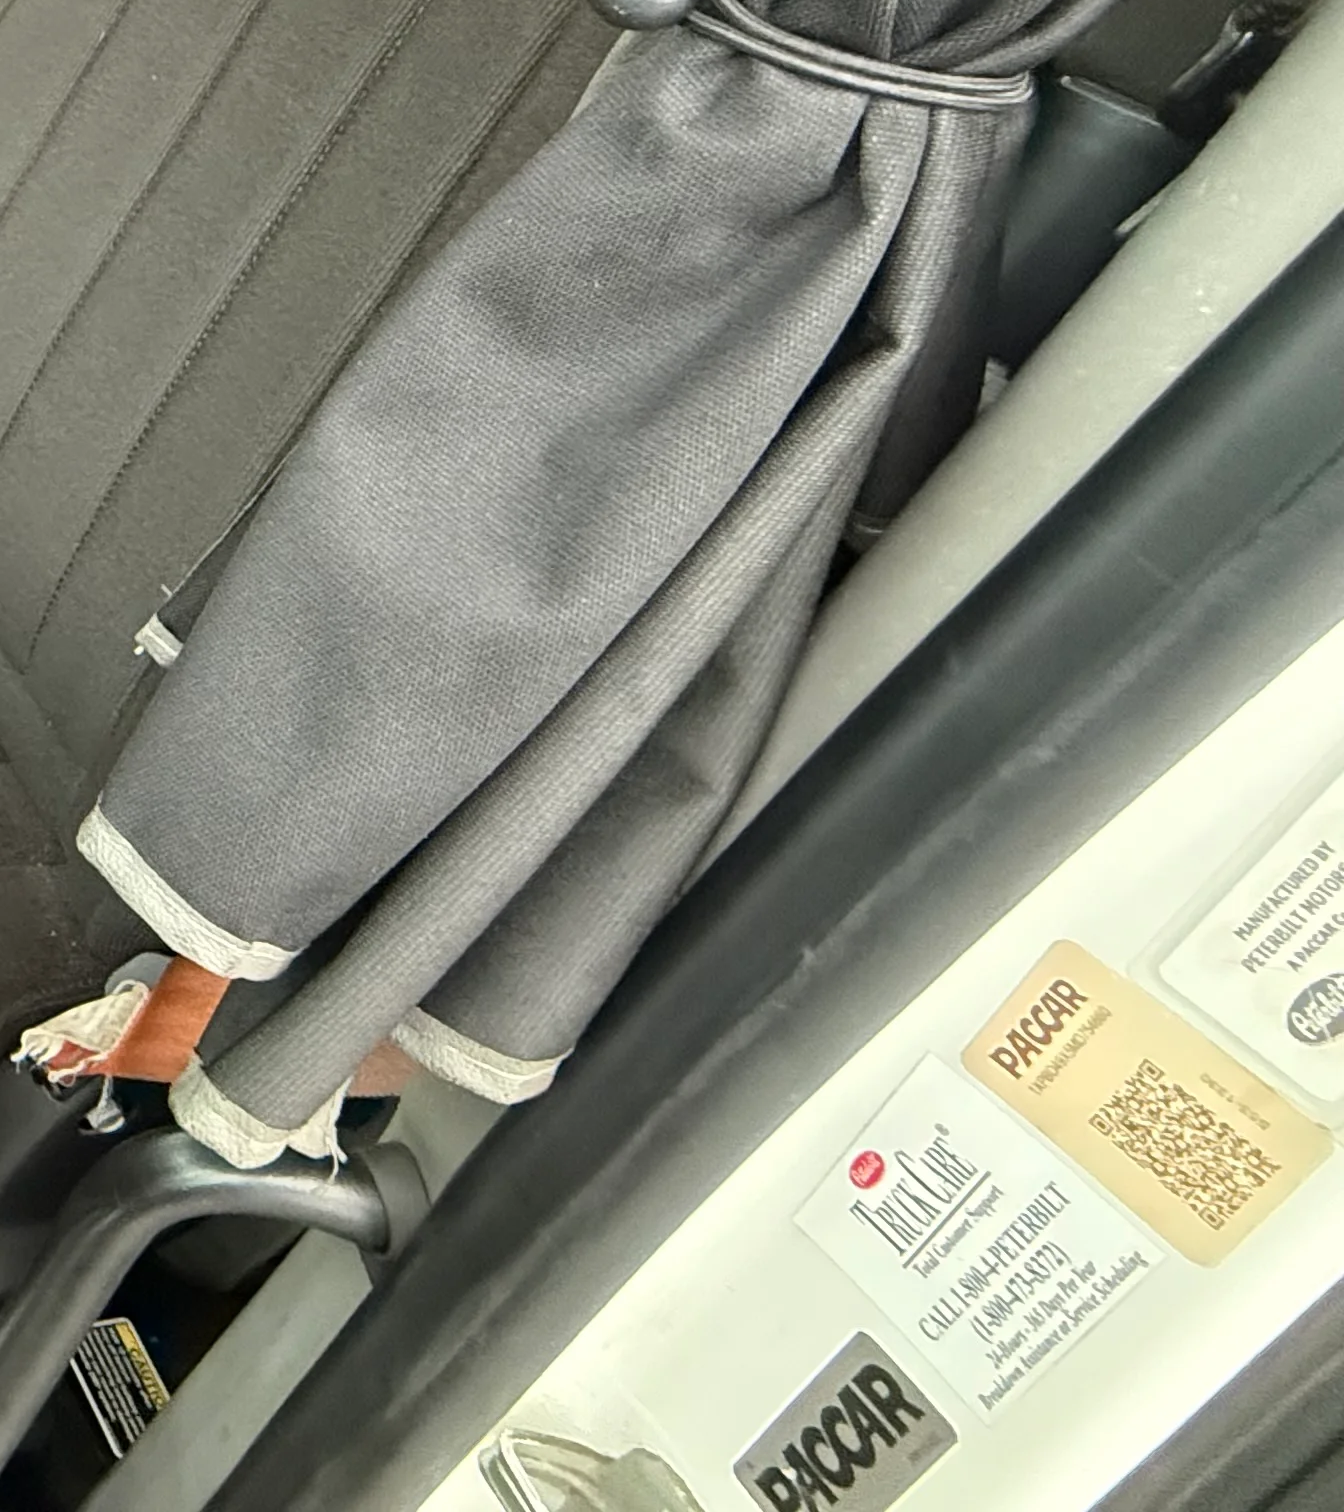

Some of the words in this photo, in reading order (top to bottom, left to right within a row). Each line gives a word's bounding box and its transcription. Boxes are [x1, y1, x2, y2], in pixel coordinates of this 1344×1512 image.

[1232, 856, 1321, 942] MANUFACTURED
[1311, 840, 1337, 863] BY
[1240, 908, 1309, 975] PETERBILT
[1286, 959, 1302, 973] A
[1292, 921, 1340, 964] PACCAR
[988, 979, 1090, 1080] PACCAR
[849, 1199, 942, 1257] TRUCK
[912, 1251, 940, 1279] Total
[932, 1218, 973, 1259] Customer
[965, 1185, 1004, 1224] Support
[918, 1297, 965, 1342] CALL
[949, 1181, 1072, 1309] 1-800-4-PETERBILT
[969, 1240, 1074, 1345] (1-800-473-8372)
[977, 1366, 1025, 1411] Breakdown
[1019, 1329, 1064, 1374] Assistance
[1062, 1292, 1101, 1328] Service
[1092, 1250, 1150, 1302] Scheduling
[1038, 1291, 1064, 1317] Days
[1056, 1277, 1079, 1300] Per
[1071, 1260, 1097, 1285] Year
[129, 1347, 165, 1410] CAUTIO
[754, 1363, 926, 1512] PACCAR
